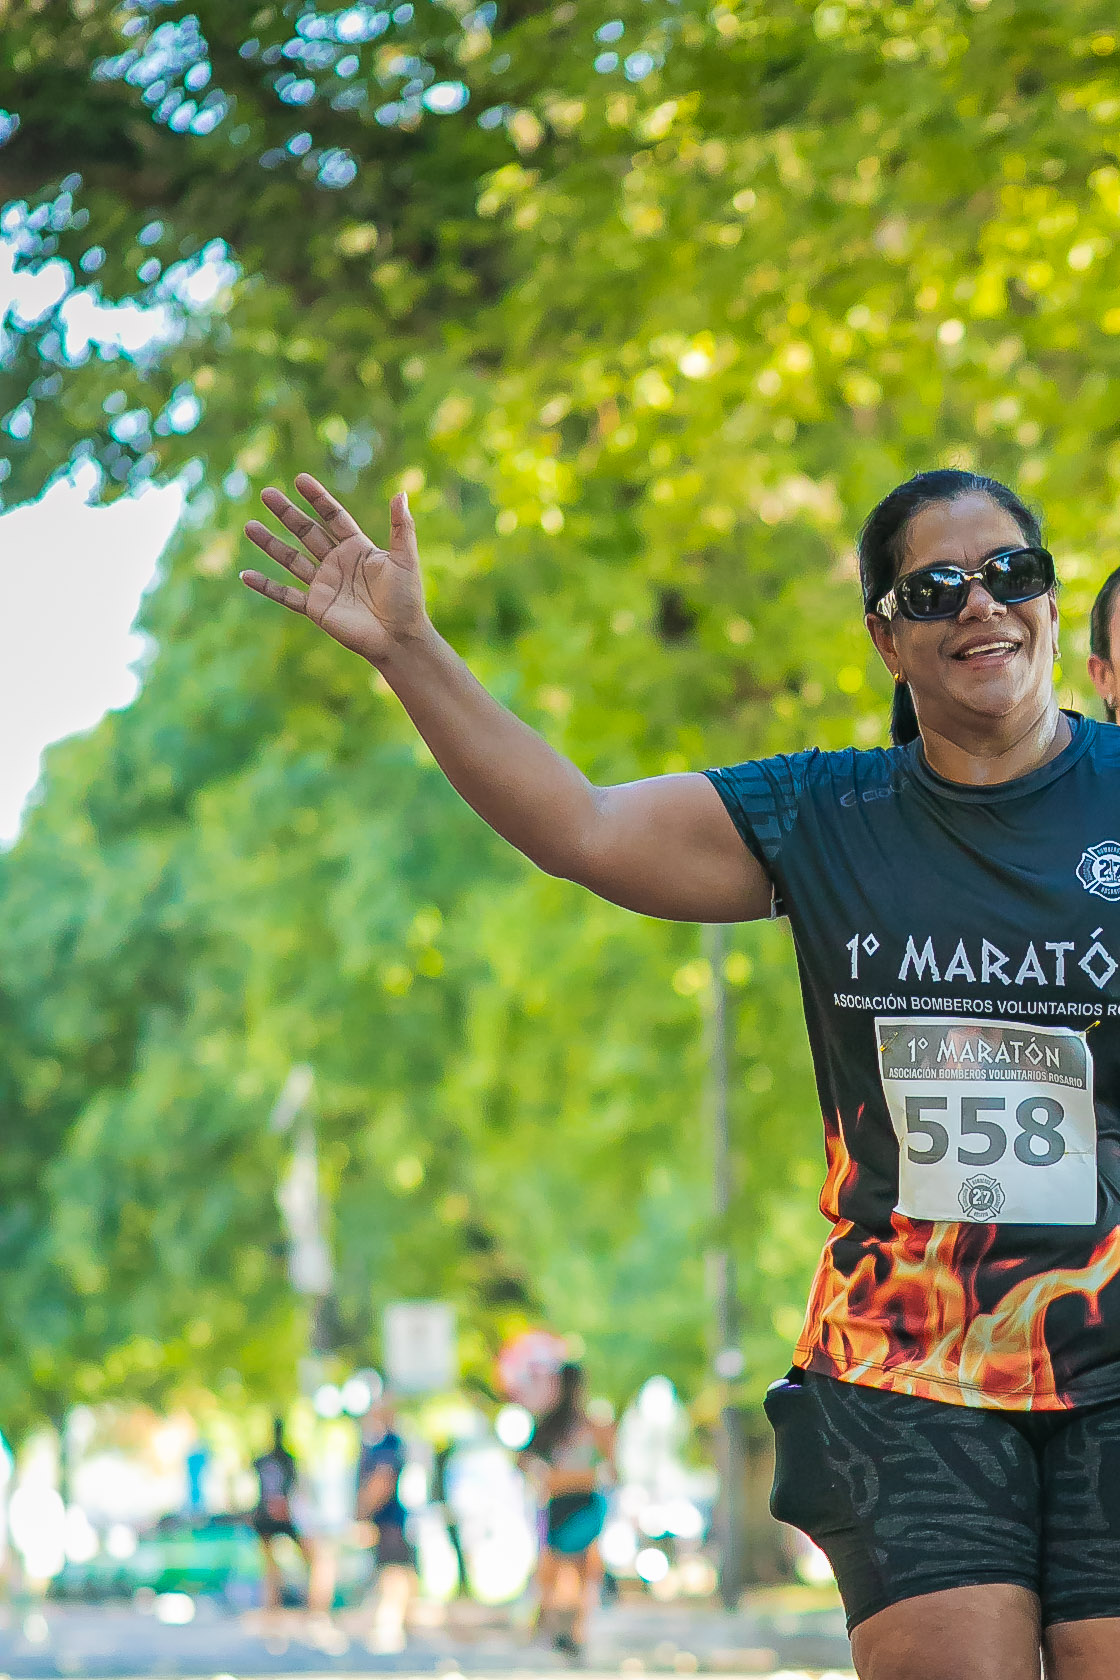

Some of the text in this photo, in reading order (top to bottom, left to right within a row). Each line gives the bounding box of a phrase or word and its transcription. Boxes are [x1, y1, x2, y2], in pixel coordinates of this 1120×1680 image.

[834, 993, 907, 1010] ASOCIACIÓN
[911, 997, 993, 1013] BOMBEROS
[997, 1000, 1103, 1016] VOLUNTARIOS
[936, 1036, 1060, 1068] MARATÓN
[889, 1066, 1083, 1088] ASOCIACIÓN BOMBEROS VOLUNTARIOS ROSARIO
[905, 1096, 1066, 1167] 558
[972, 1188, 991, 1205] 27
